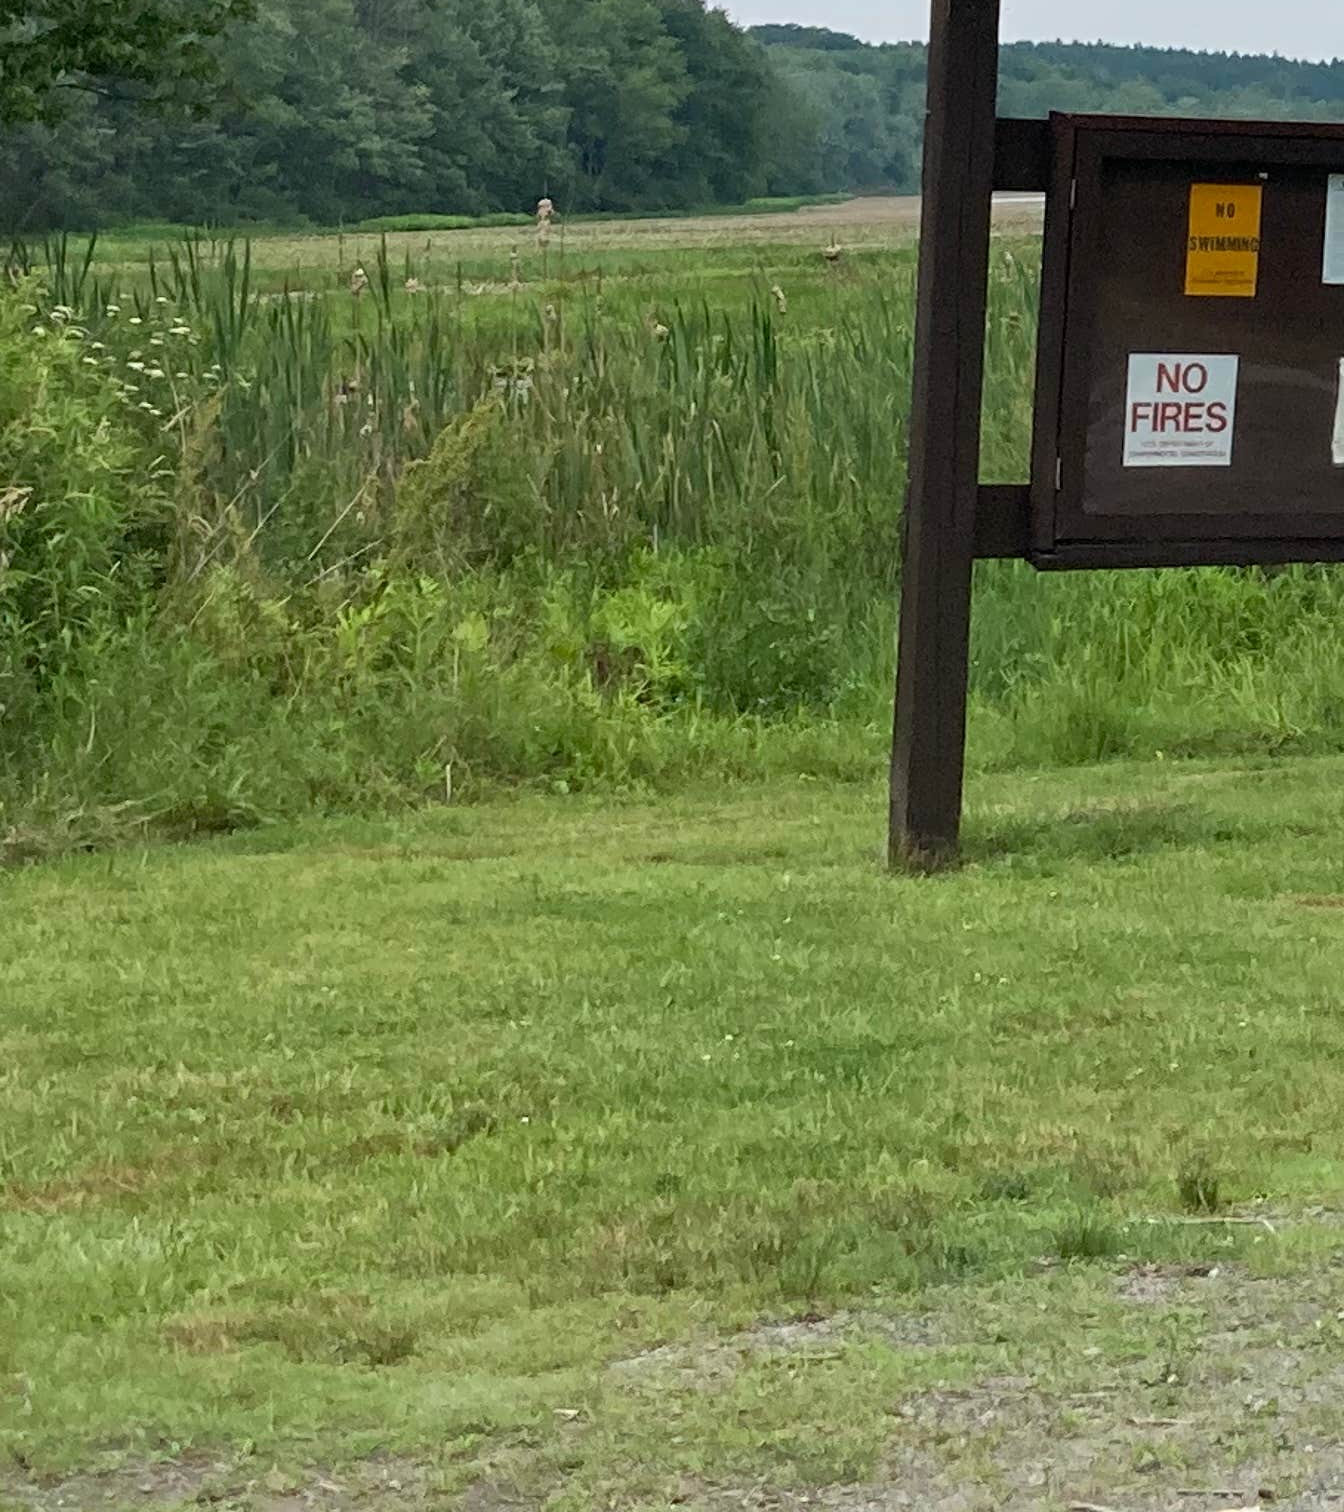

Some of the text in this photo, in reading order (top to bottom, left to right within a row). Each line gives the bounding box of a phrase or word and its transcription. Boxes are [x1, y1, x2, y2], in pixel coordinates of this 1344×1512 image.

[1215, 202, 1236, 218] NO
[1189, 235, 1260, 252] SWIMMING
[1156, 362, 1208, 393] NO
[1131, 401, 1228, 433] FIRES
